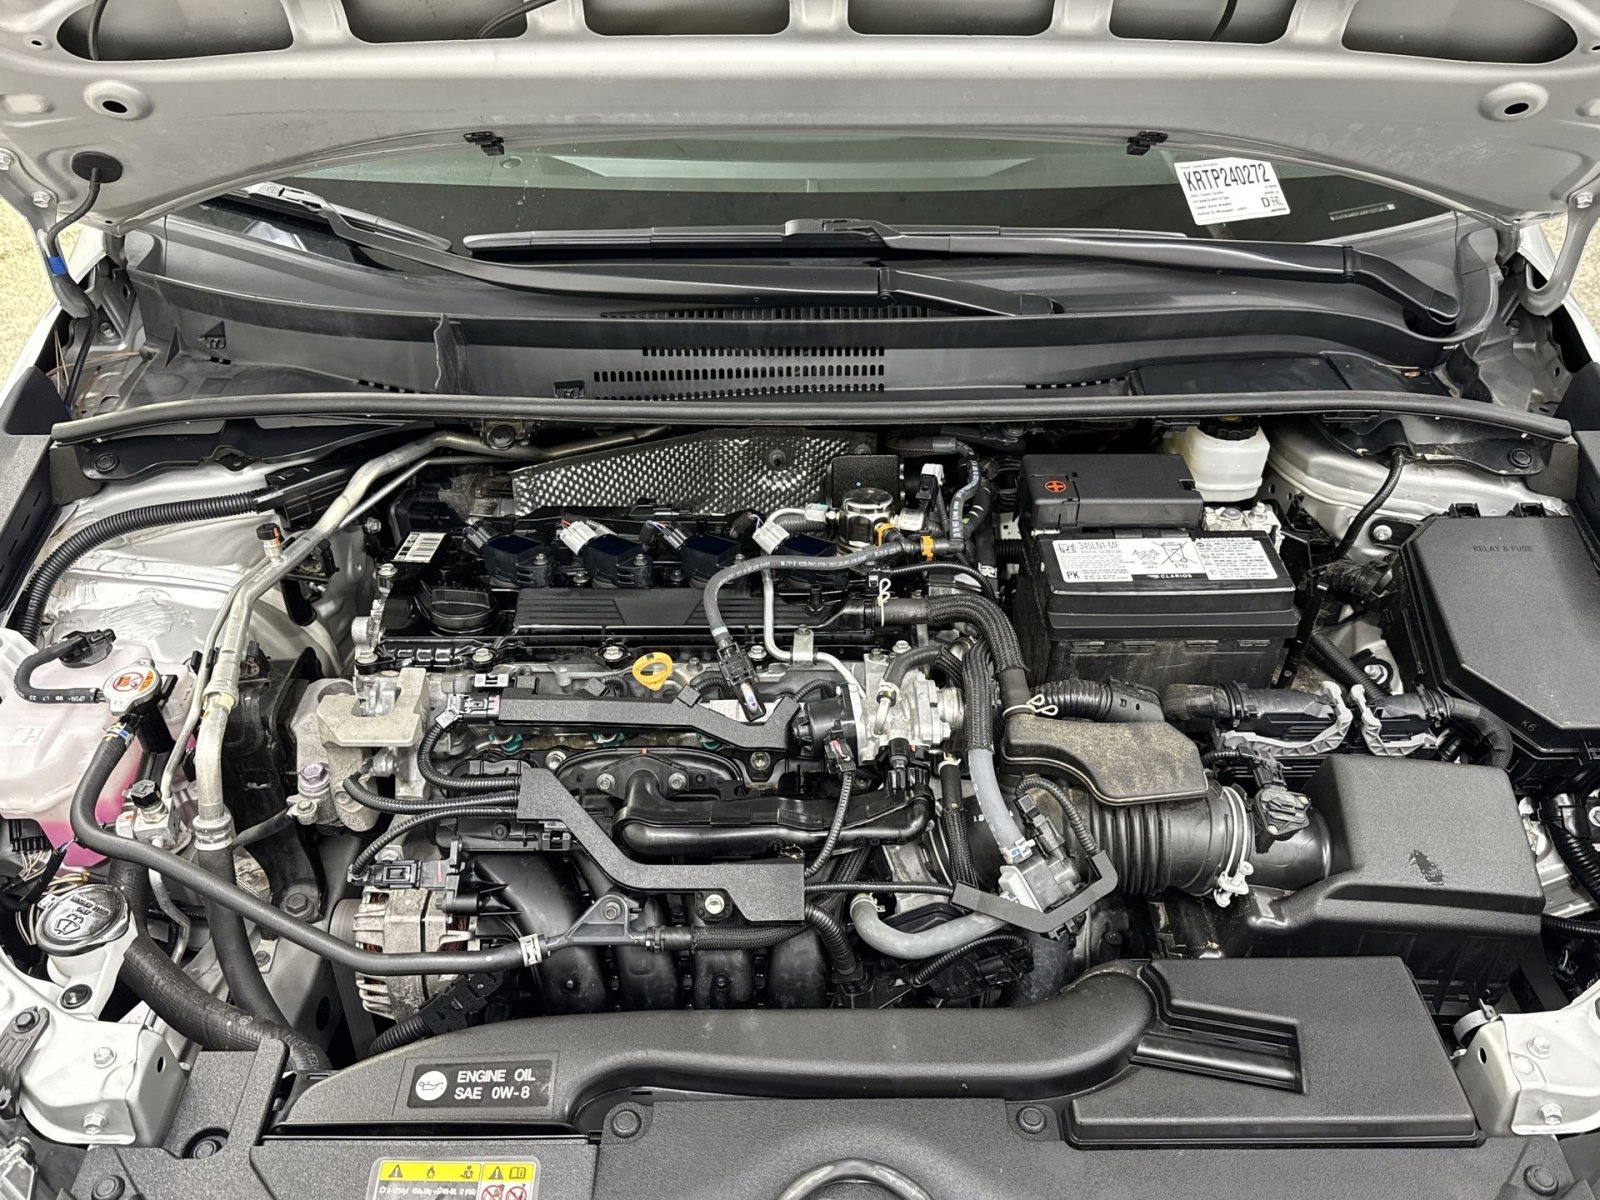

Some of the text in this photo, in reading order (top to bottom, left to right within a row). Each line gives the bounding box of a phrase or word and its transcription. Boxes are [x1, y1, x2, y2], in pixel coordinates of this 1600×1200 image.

[1183, 163, 1271, 192] KRTP240272
[1261, 197, 1270, 207] D
[1066, 571, 1080, 579] PK
[456, 1068, 536, 1083] ENGINE OIL
[454, 1085, 531, 1100] SAE 0W-8
